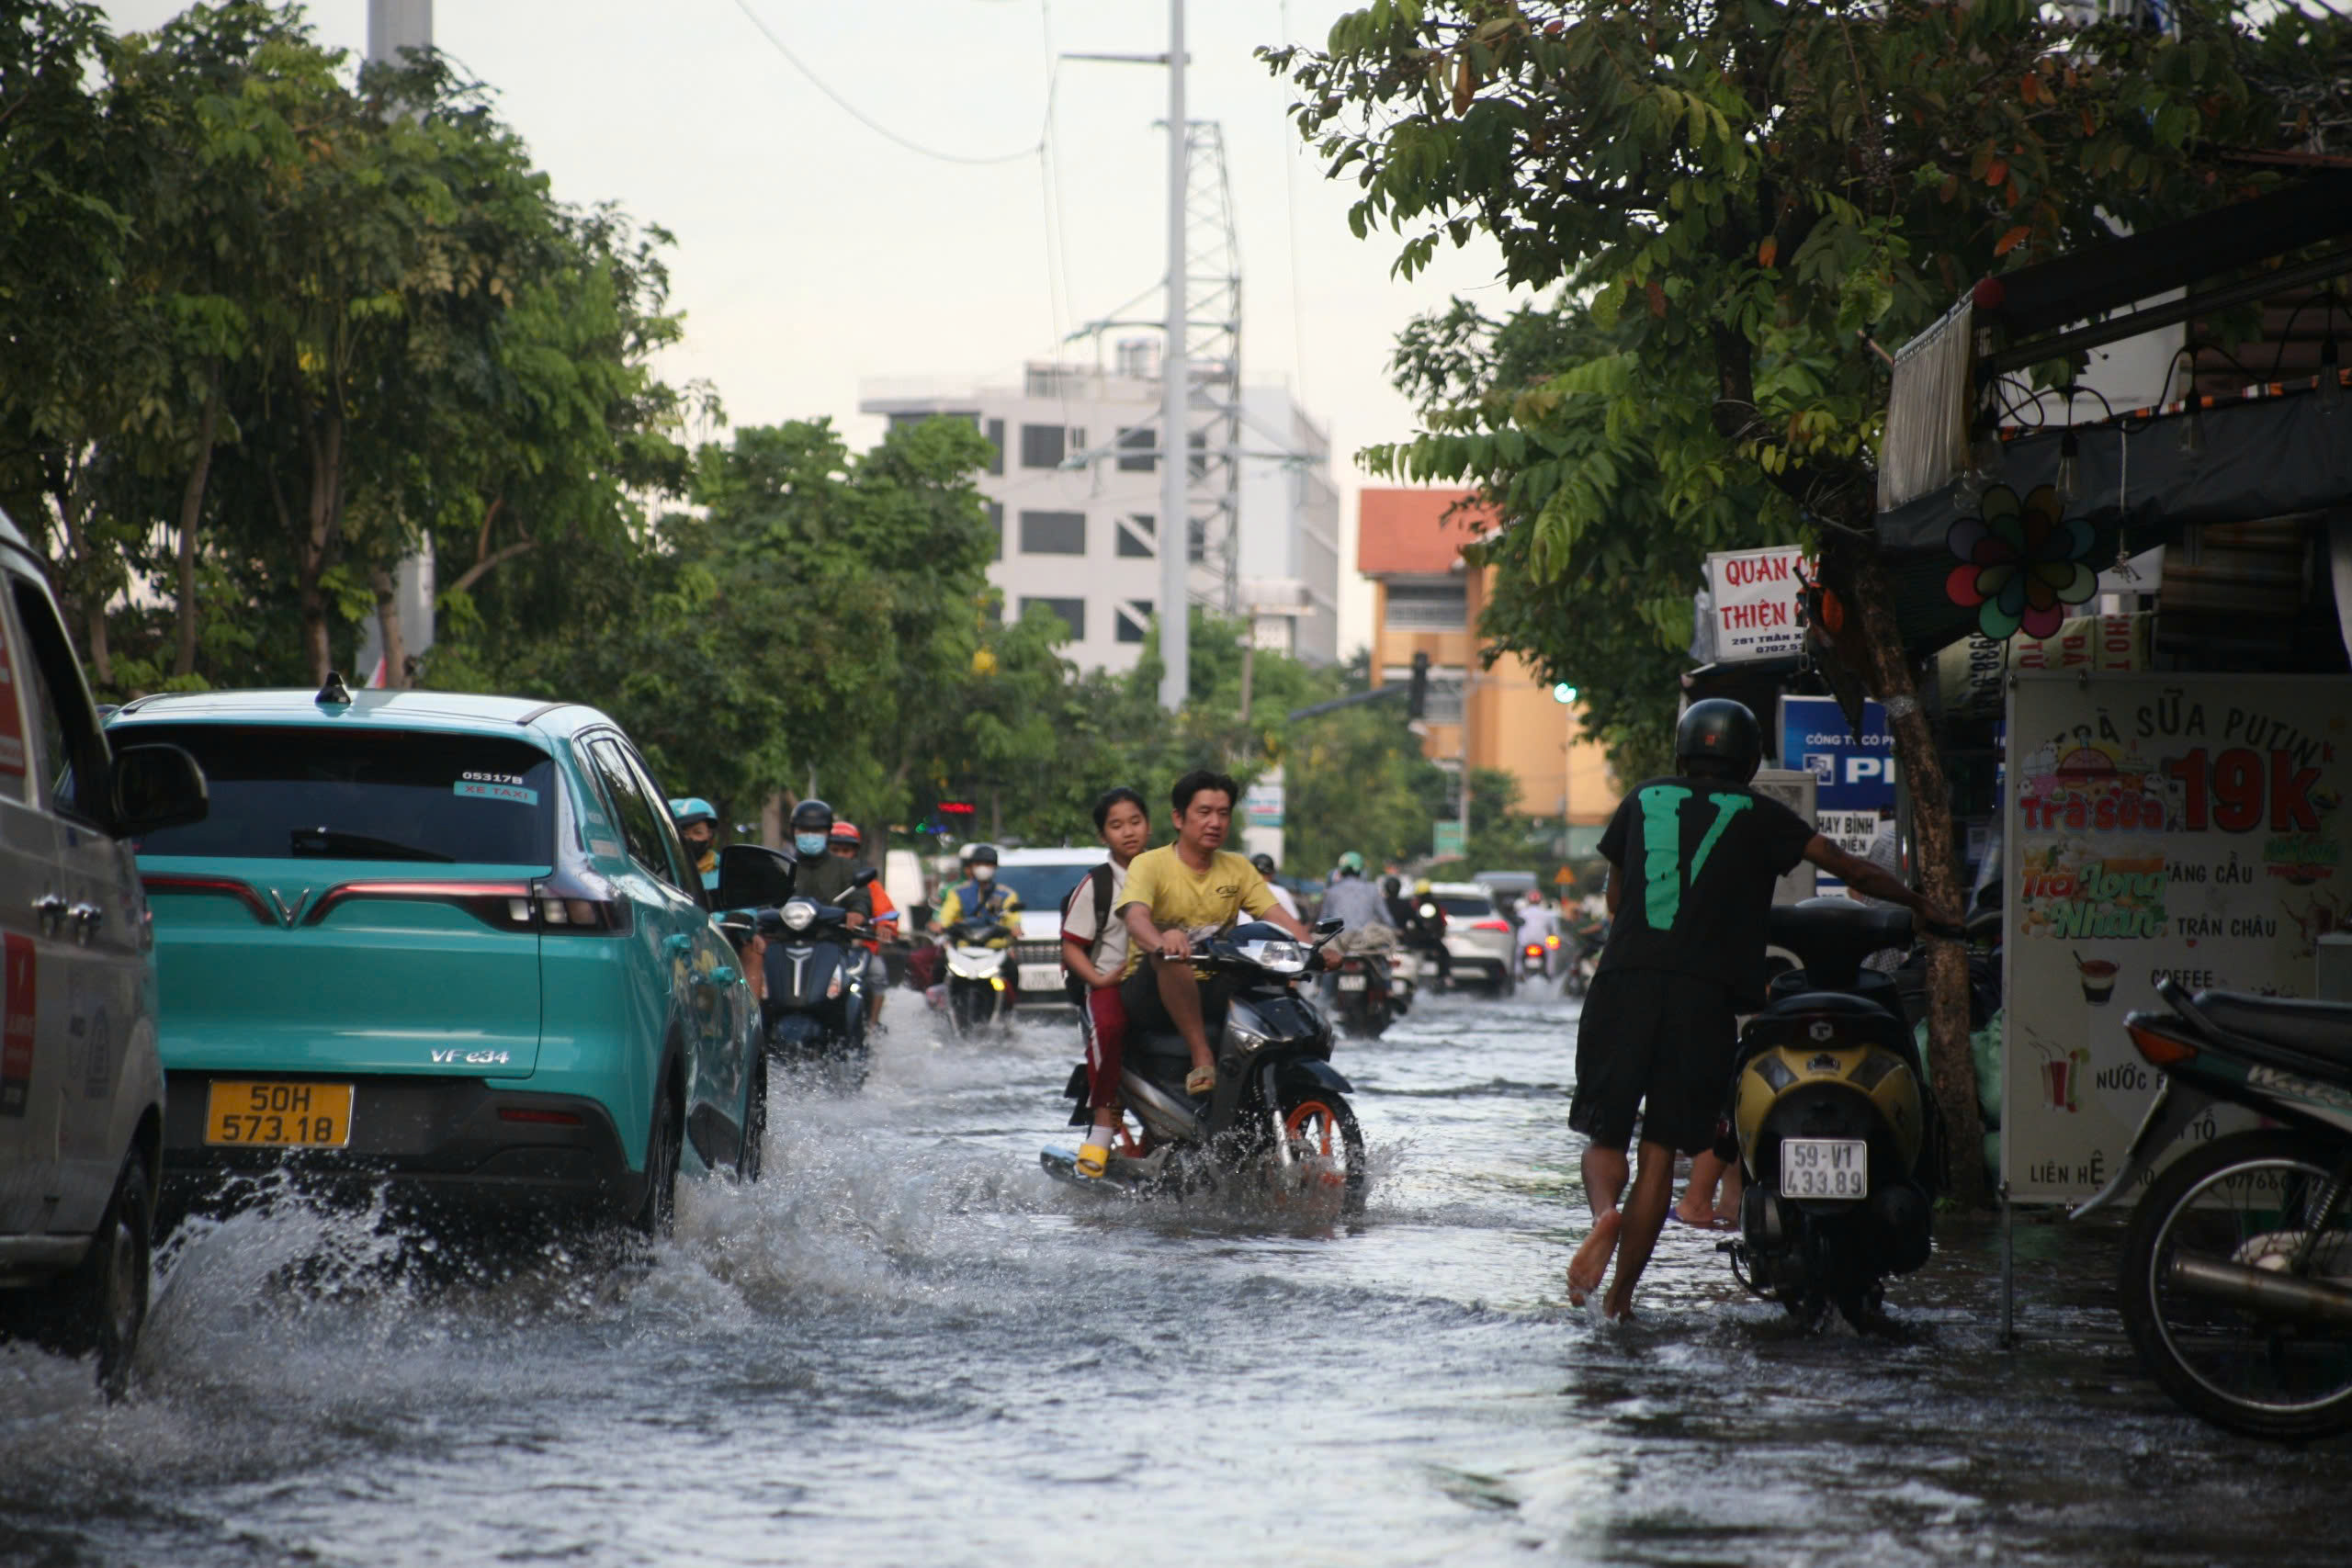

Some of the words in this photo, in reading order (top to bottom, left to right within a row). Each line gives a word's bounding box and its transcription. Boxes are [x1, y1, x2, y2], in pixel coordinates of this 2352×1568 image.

[1720, 598, 1787, 632] THIỆN
[1805, 732, 1841, 746] CÔNG
[465, 785, 486, 795] XE
[492, 787, 528, 799] TAXI
[2169, 748, 2323, 833] 19k
[2019, 793, 2088, 831] Trà
[2215, 850, 2253, 885] CẦU
[2231, 915, 2277, 938] CHÂU
[431, 1049, 464, 1063] VF
[465, 1049, 510, 1064] e34
[2096, 1062, 2147, 1090] NƯỚC
[250, 1085, 311, 1111] 50H
[222, 1115, 333, 1142] 573.18
[1786, 1170, 1862, 1195] 433.89
[2030, 1160, 2068, 1185] LIÊN
[2077, 1150, 2105, 1191] HỆ
